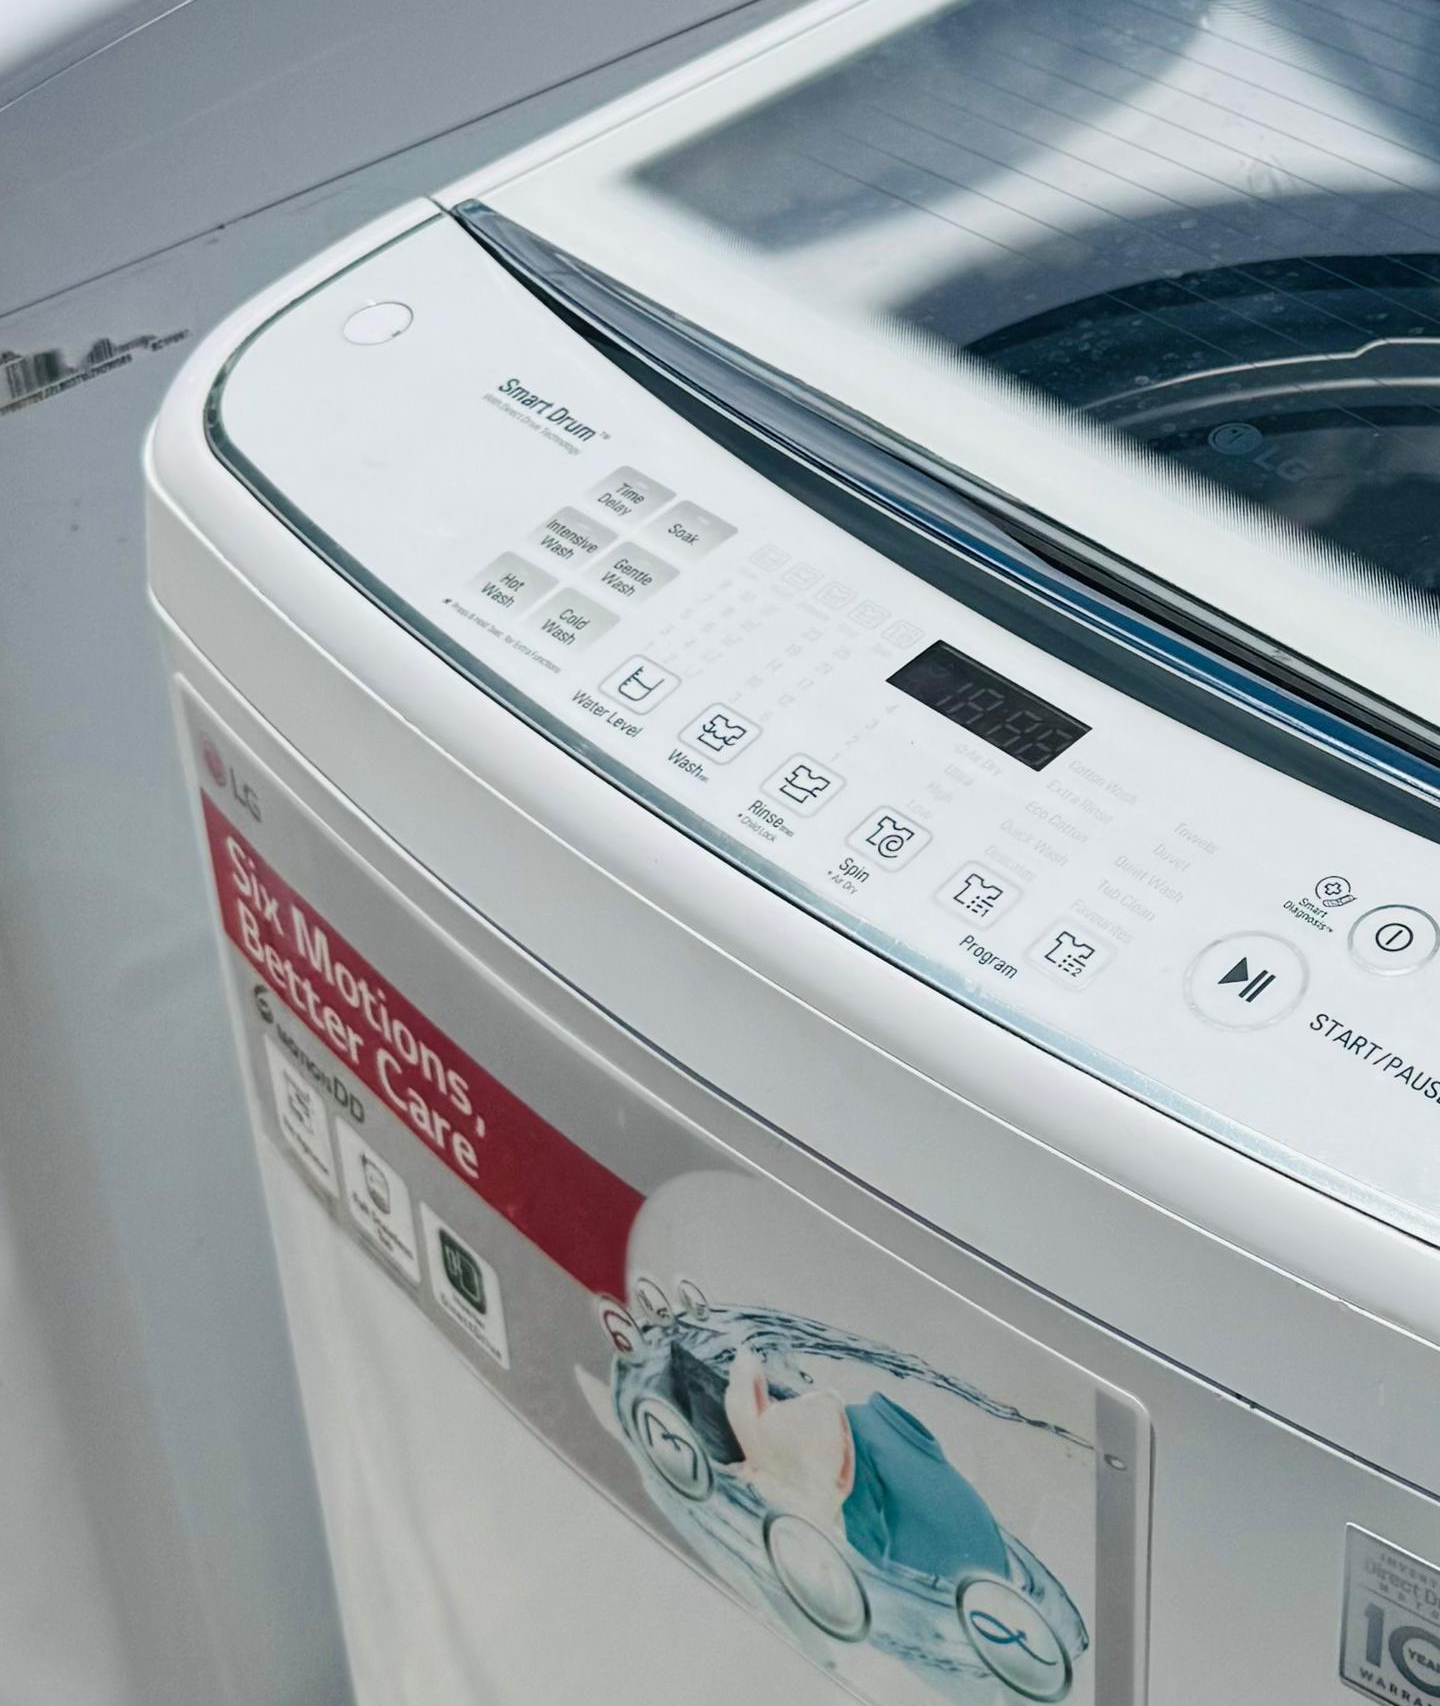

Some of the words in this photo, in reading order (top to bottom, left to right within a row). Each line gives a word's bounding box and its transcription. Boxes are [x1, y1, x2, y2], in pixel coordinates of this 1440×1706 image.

[498, 378, 554, 415] Smart
[597, 493, 632, 518] Delay
[615, 481, 646, 505] Time
[540, 534, 575, 561] Wash
[545, 517, 599, 555] Intensive
[667, 522, 700, 547] Soak
[499, 572, 526, 594] Hot
[600, 571, 636, 598] Wash
[612, 557, 654, 587] Gentle
[480, 581, 516, 609] Wash
[540, 618, 576, 646] Wash
[558, 607, 592, 632] Cold
[571, 688, 608, 721] Water
[606, 711, 644, 739] Level
[668, 748, 703, 778] Wash
[229, 766, 263, 823] LG
[1104, 779, 1139, 806] Wash
[747, 799, 785, 829] Rinse
[1024, 799, 1047, 820] Eco
[1047, 812, 1090, 845] Cotton
[1032, 839, 1072, 868] Wash
[1152, 843, 1192, 874] Duvet
[837, 857, 871, 885] Spin
[1096, 878, 1121, 902] Tub
[1119, 893, 1159, 924] Clean
[1146, 875, 1184, 905] Wash
[1298, 897, 1328, 919] Smart
[957, 933, 1020, 981] Program
[225, 835, 283, 934] Six
[292, 905, 486, 1140] Motions,
[237, 900, 365, 1064] Better
[375, 1044, 481, 1181] Care
[1363, 1557, 1420, 1598] Direct
